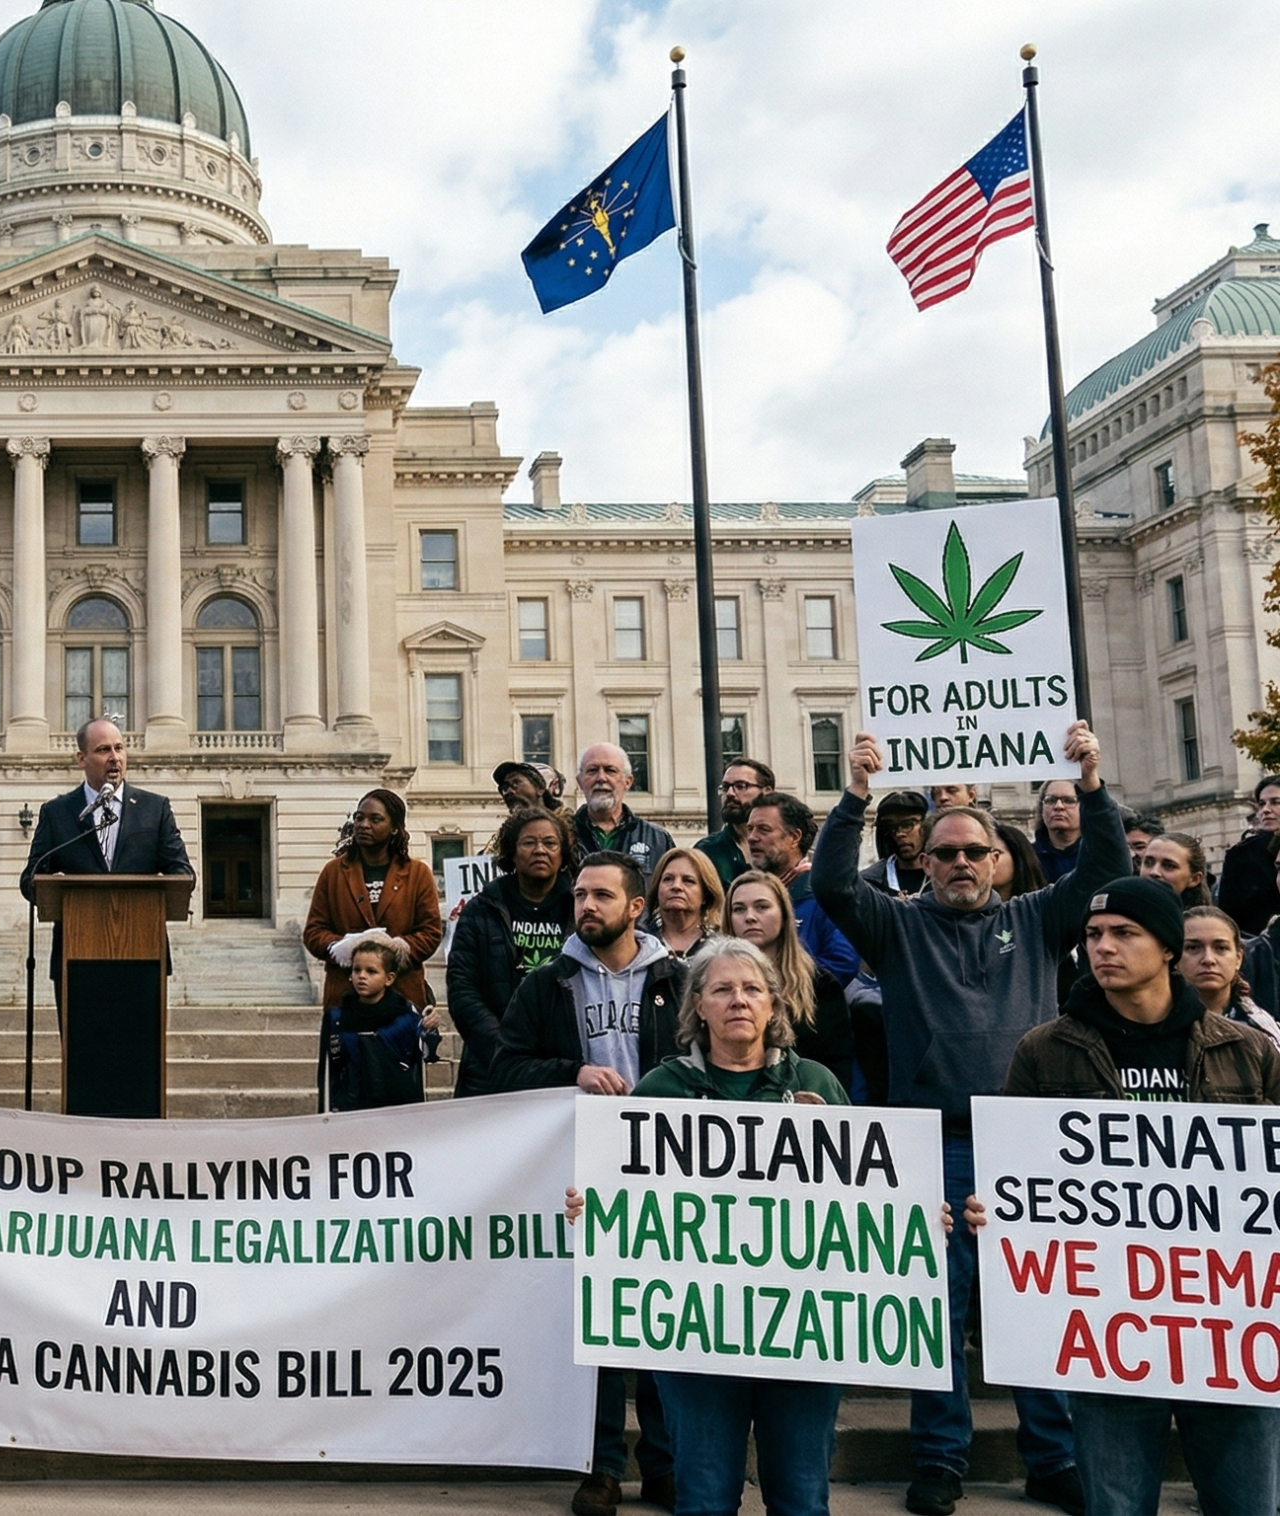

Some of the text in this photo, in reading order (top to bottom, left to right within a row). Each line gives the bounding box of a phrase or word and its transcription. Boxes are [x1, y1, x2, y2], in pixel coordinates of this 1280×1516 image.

[868, 674, 1069, 718] FOR ADULTS
[956, 715, 978, 731] IN
[886, 730, 1056, 773] INDIANA
[100, 1155, 311, 1201] RALLYING
[328, 1151, 414, 1200] FOR
[620, 1111, 899, 1189] INDIANA
[994, 1175, 1222, 1233] SESSION
[191, 1215, 472, 1264] LEGALIZATION
[489, 1213, 575, 1260] BILL
[581, 1187, 938, 1280] MARIJUANA
[1000, 1238, 1101, 1297] WE
[105, 1279, 197, 1329] AND
[581, 1274, 944, 1370] LEGALIZATION
[34, 1340, 261, 1399] CANNABIS
[277, 1349, 373, 1398] BILL
[388, 1346, 504, 1399] 2025
[1055, 1308, 1280, 1394] ACTIO
